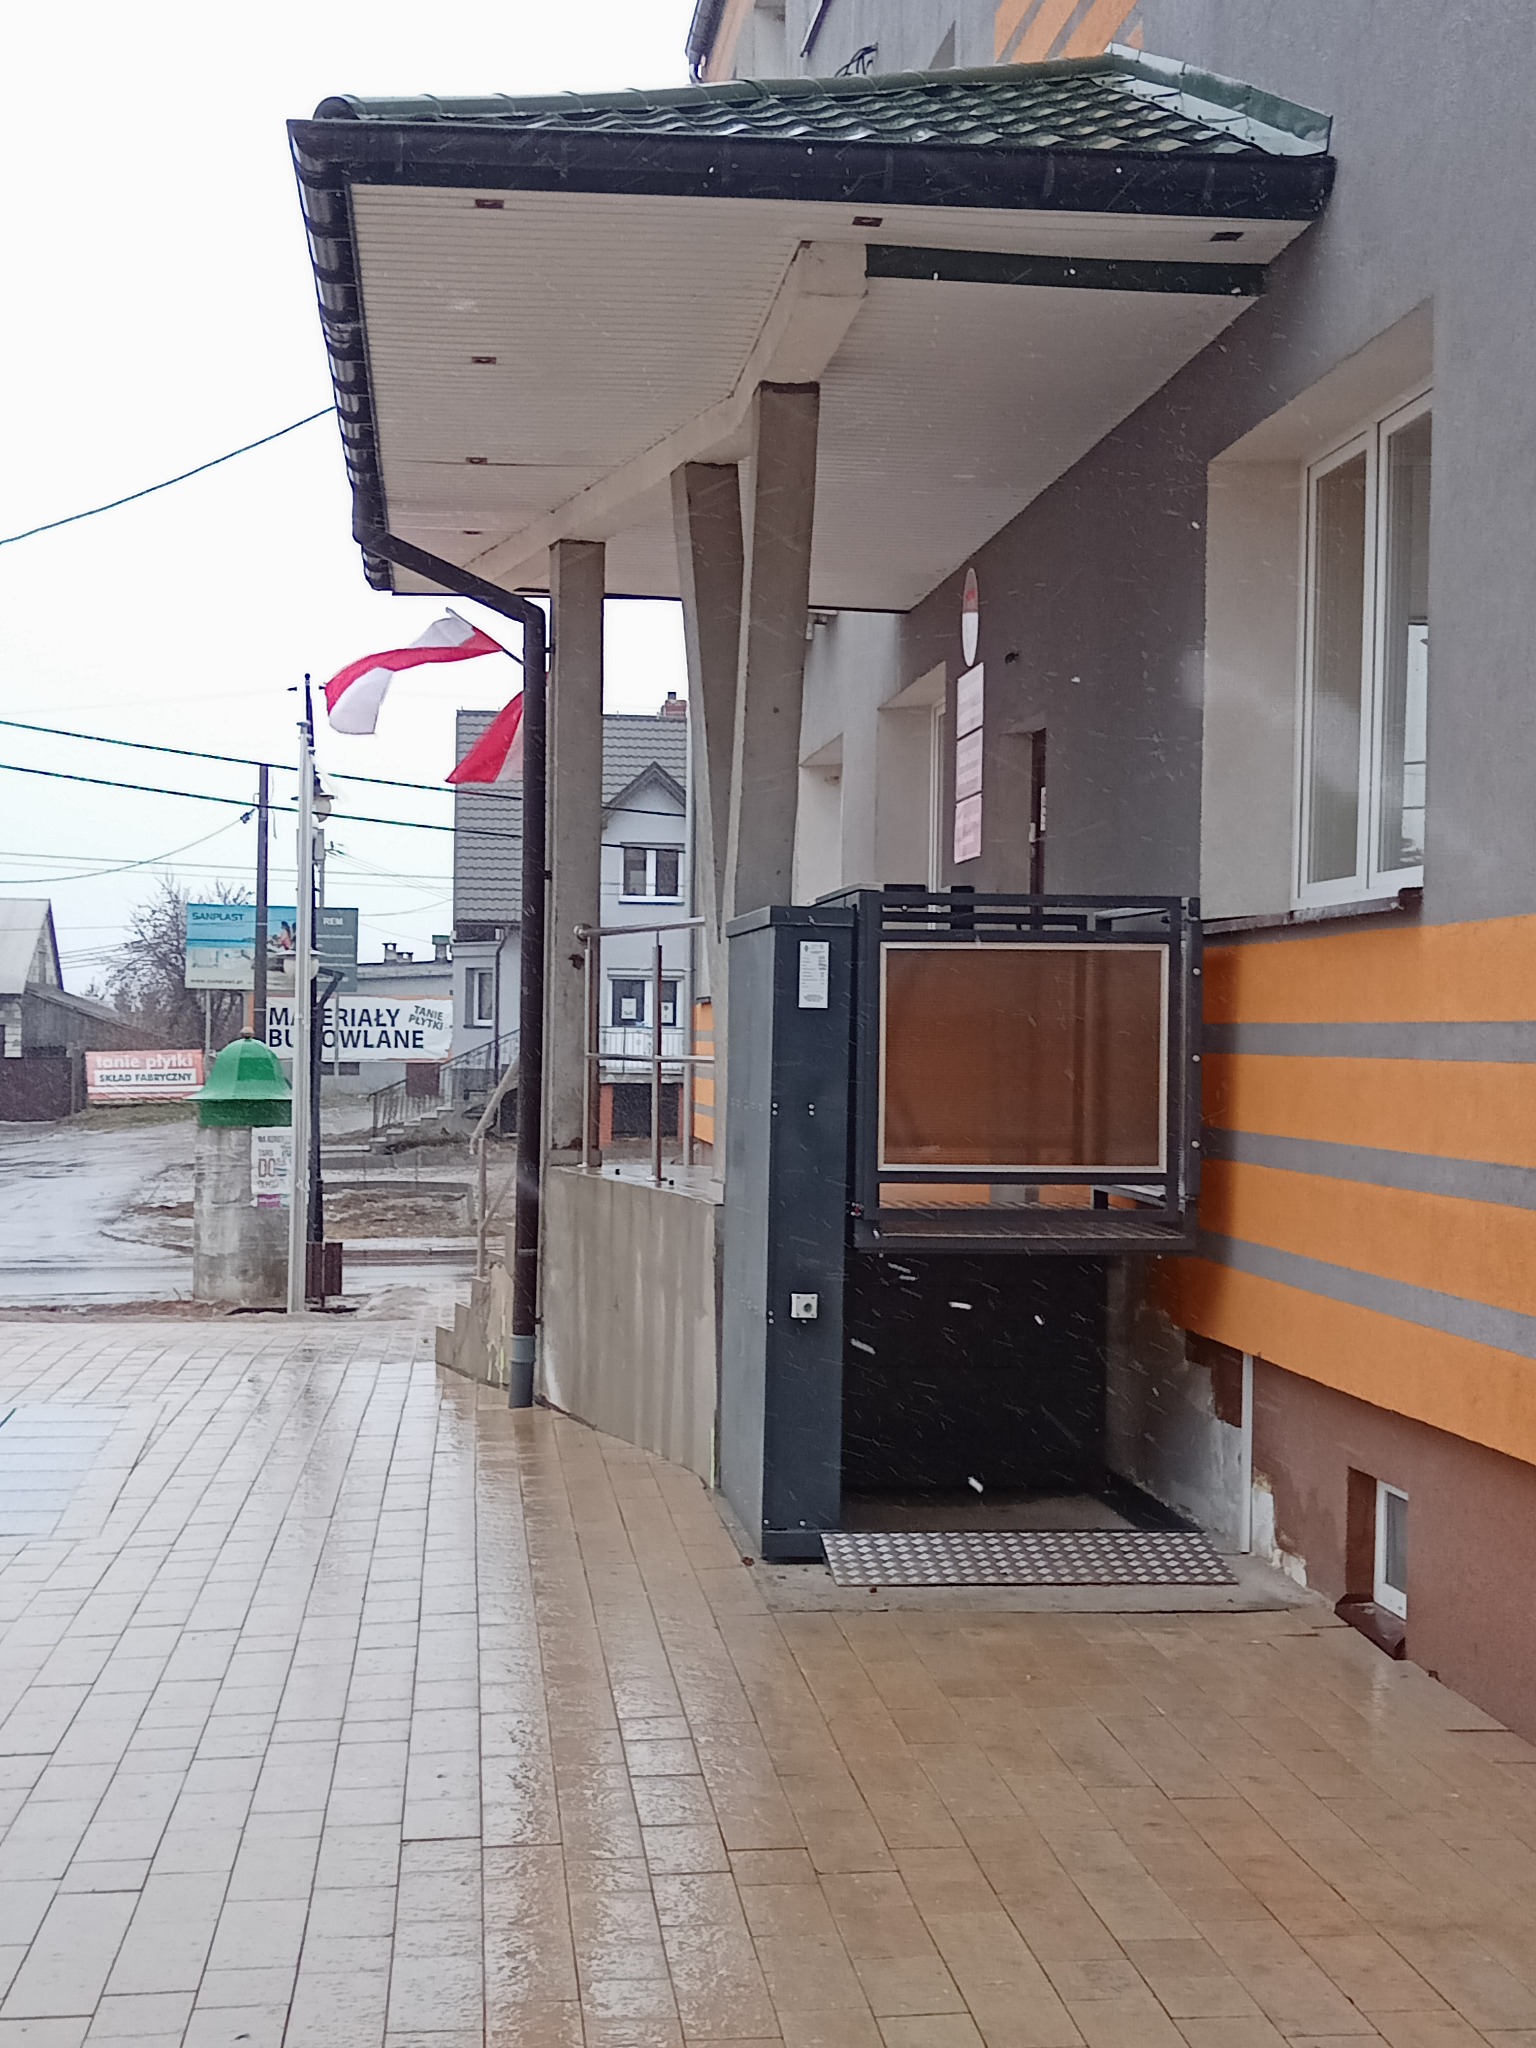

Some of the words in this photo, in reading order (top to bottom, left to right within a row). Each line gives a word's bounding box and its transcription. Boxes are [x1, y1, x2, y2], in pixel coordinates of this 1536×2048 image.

[269, 1007, 401, 1028] MERIAŁY
[408, 1013, 445, 1031] PŁYTKI
[413, 1004, 444, 1022] TANIE
[269, 1028, 425, 1050] BUOWLANE
[95, 1055, 141, 1069] tanie
[99, 1074, 133, 1083] SKŁAD
[135, 1072, 193, 1082] FABRYCZNY
